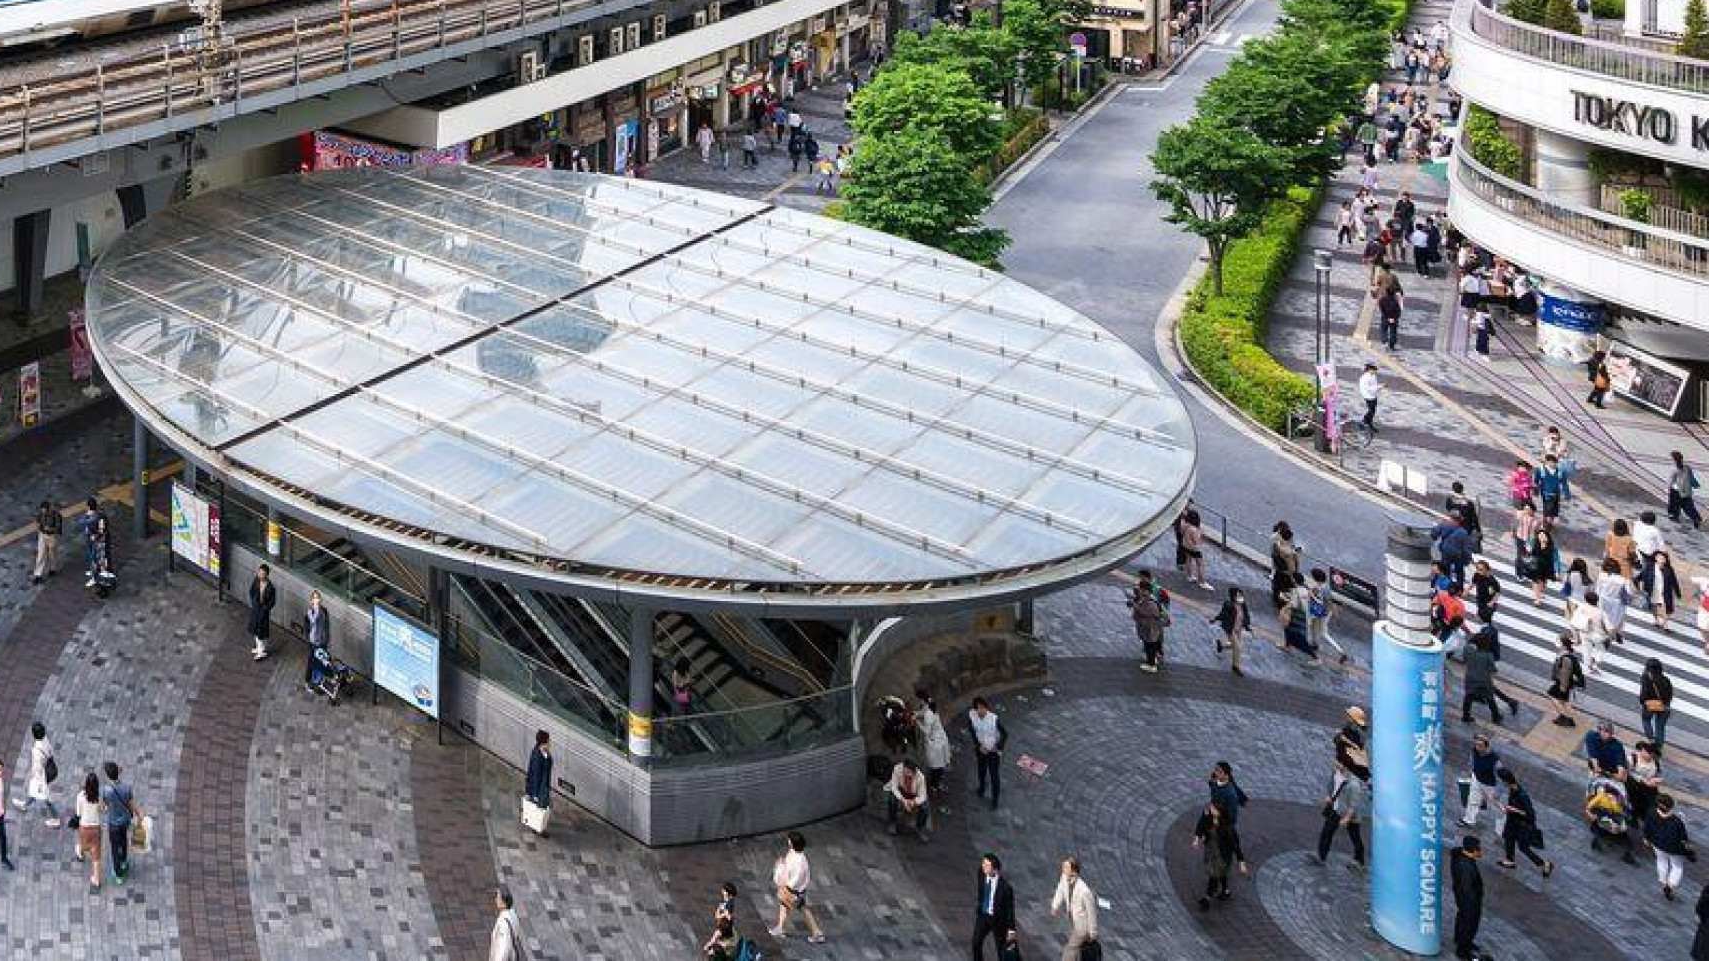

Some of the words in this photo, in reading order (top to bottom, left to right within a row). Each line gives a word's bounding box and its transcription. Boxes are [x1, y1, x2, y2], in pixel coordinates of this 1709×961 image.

[1570, 89, 1678, 146] TOKYO
[1420, 772, 1437, 840] HAPPY
[1420, 849, 1436, 935] SQUARE
